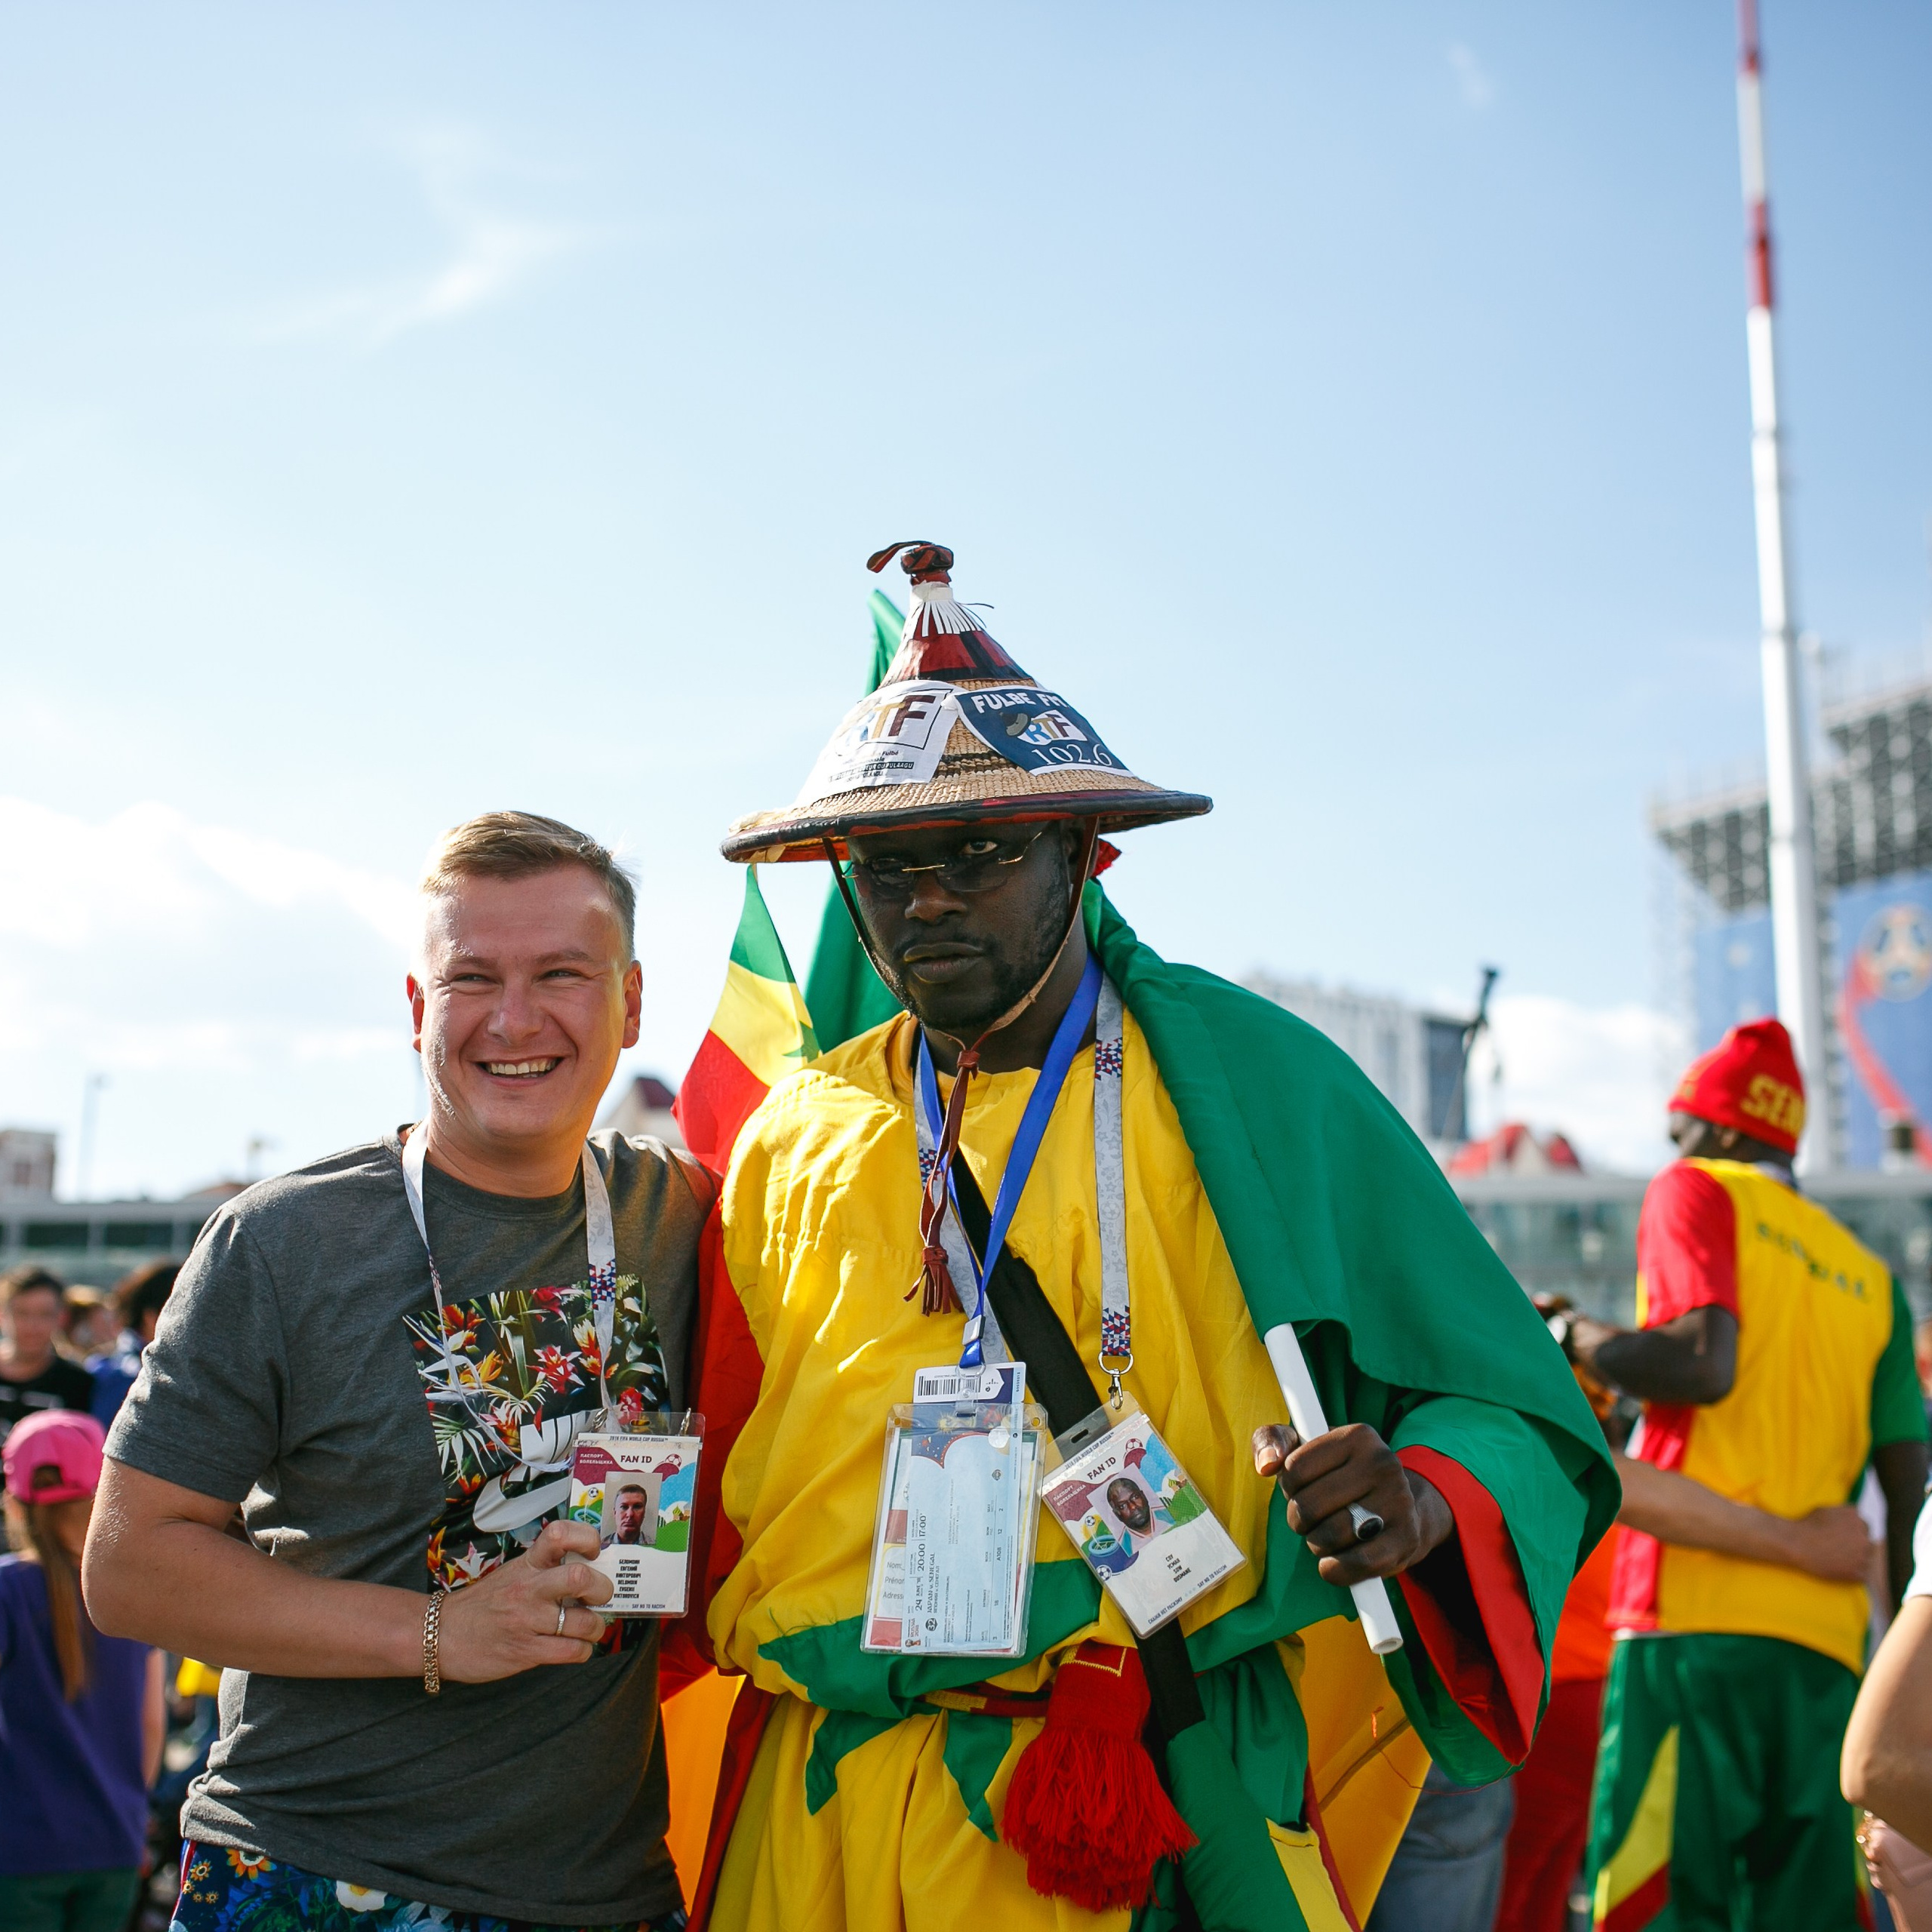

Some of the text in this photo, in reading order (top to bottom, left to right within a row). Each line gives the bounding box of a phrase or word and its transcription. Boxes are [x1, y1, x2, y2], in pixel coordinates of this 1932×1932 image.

[971, 693, 1036, 714] FULBE
[1025, 714, 1070, 742] RTF
[1032, 744, 1112, 766] 102.6
[1087, 1457, 1116, 1480] FAN ID
[918, 1543, 926, 1571] 20:00
[916, 1599, 923, 1611] 24
[928, 1618, 936, 1631] 32
